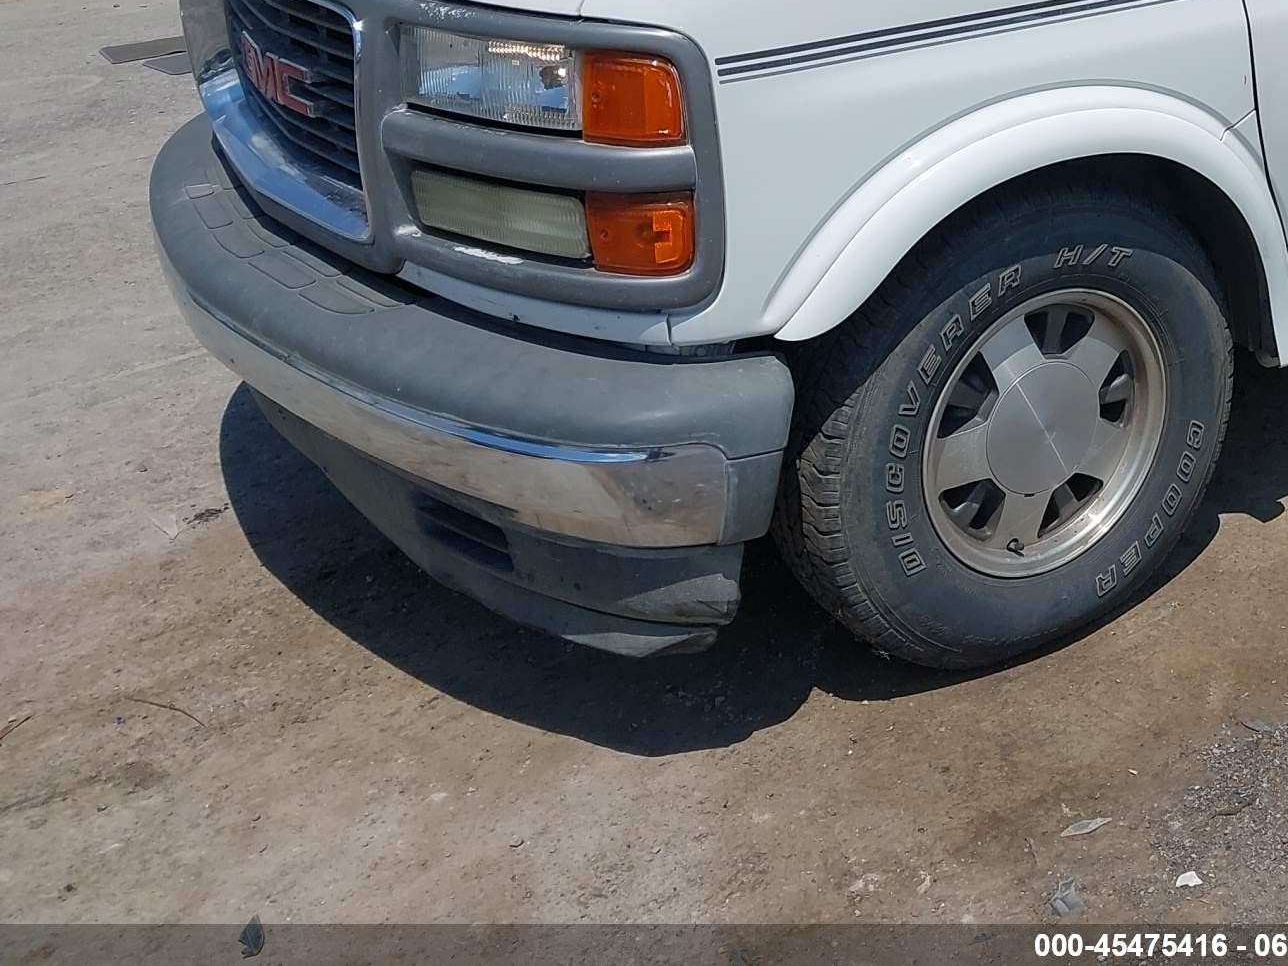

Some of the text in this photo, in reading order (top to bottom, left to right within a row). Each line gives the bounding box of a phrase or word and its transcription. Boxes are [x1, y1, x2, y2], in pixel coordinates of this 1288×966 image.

[240, 30, 315, 118] GMC
[886, 244, 1133, 578] DISCOVERER H/T
[1096, 420, 1205, 597] COOPER
